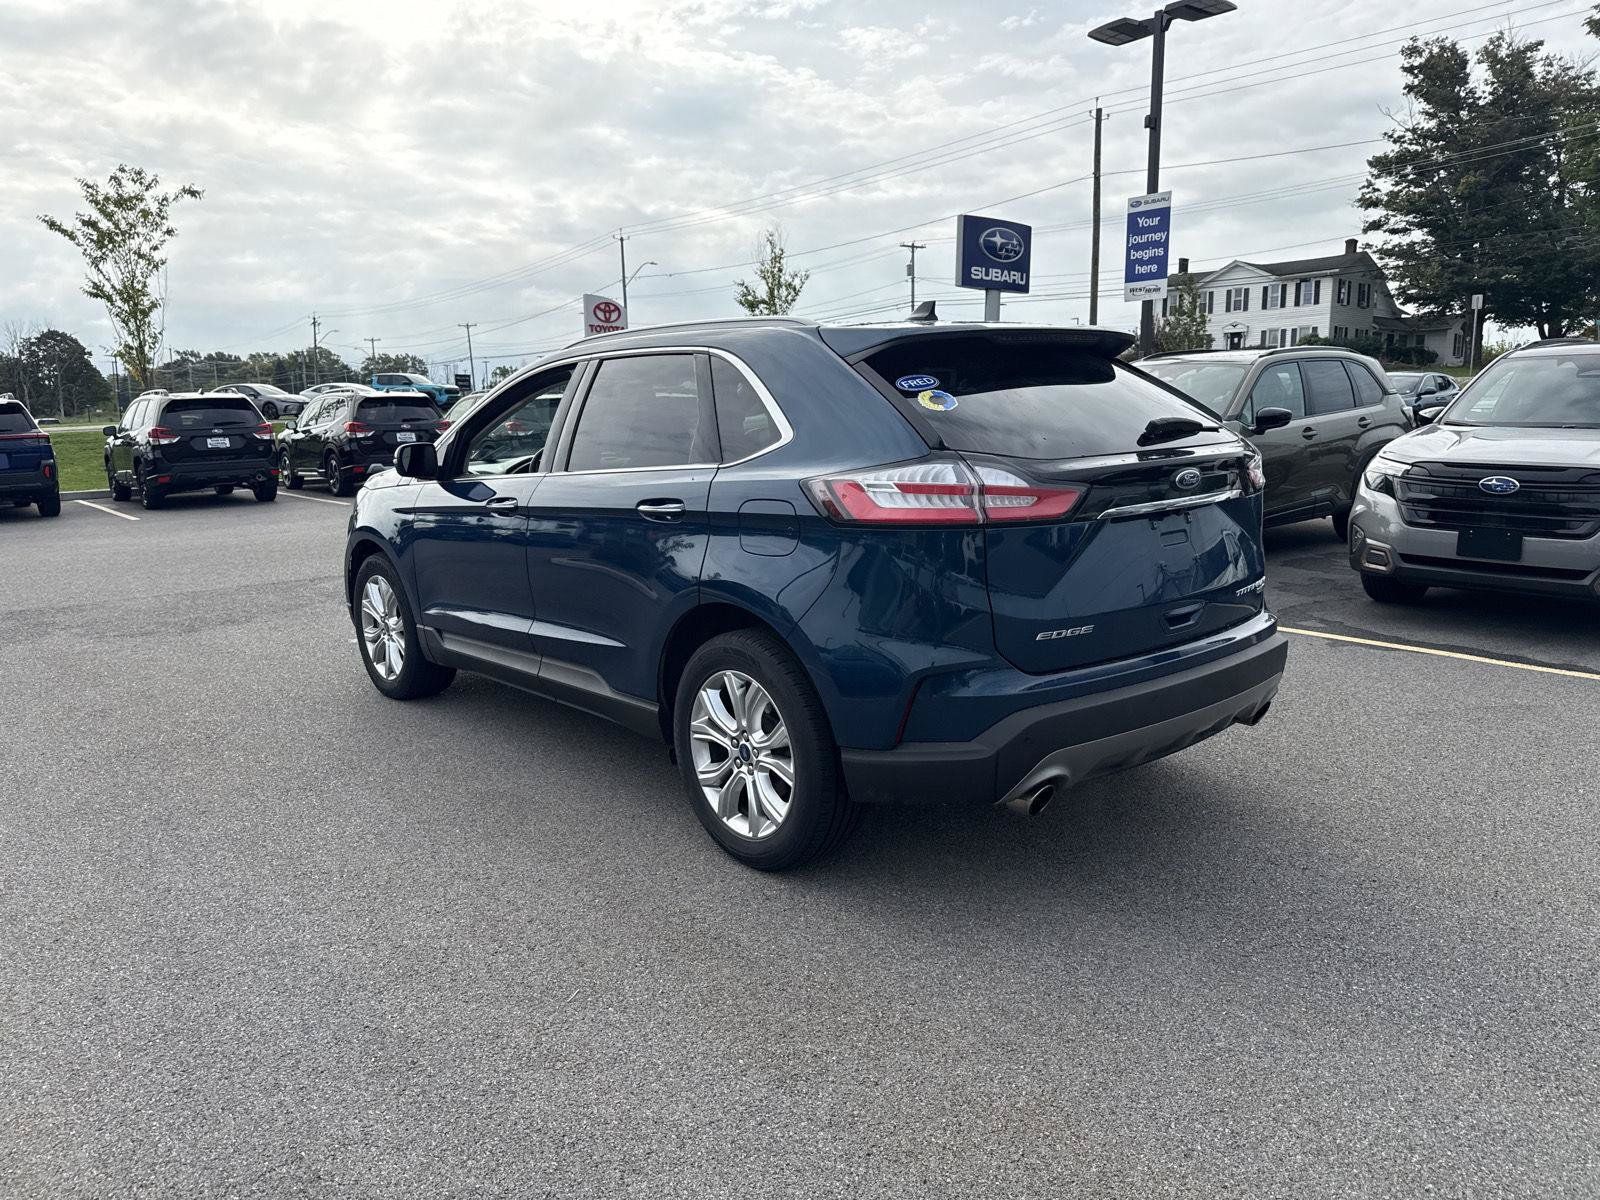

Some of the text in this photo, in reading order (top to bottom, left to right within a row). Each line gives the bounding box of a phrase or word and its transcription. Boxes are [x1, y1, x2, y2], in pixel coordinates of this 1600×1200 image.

[1137, 216, 1161, 227] Your
[1128, 231, 1168, 247] journey
[1130, 246, 1164, 260] begins
[970, 266, 1026, 285] SUBARU
[1135, 263, 1158, 274] here
[901, 377, 934, 388] FRED
[1035, 624, 1095, 641] EDGE
